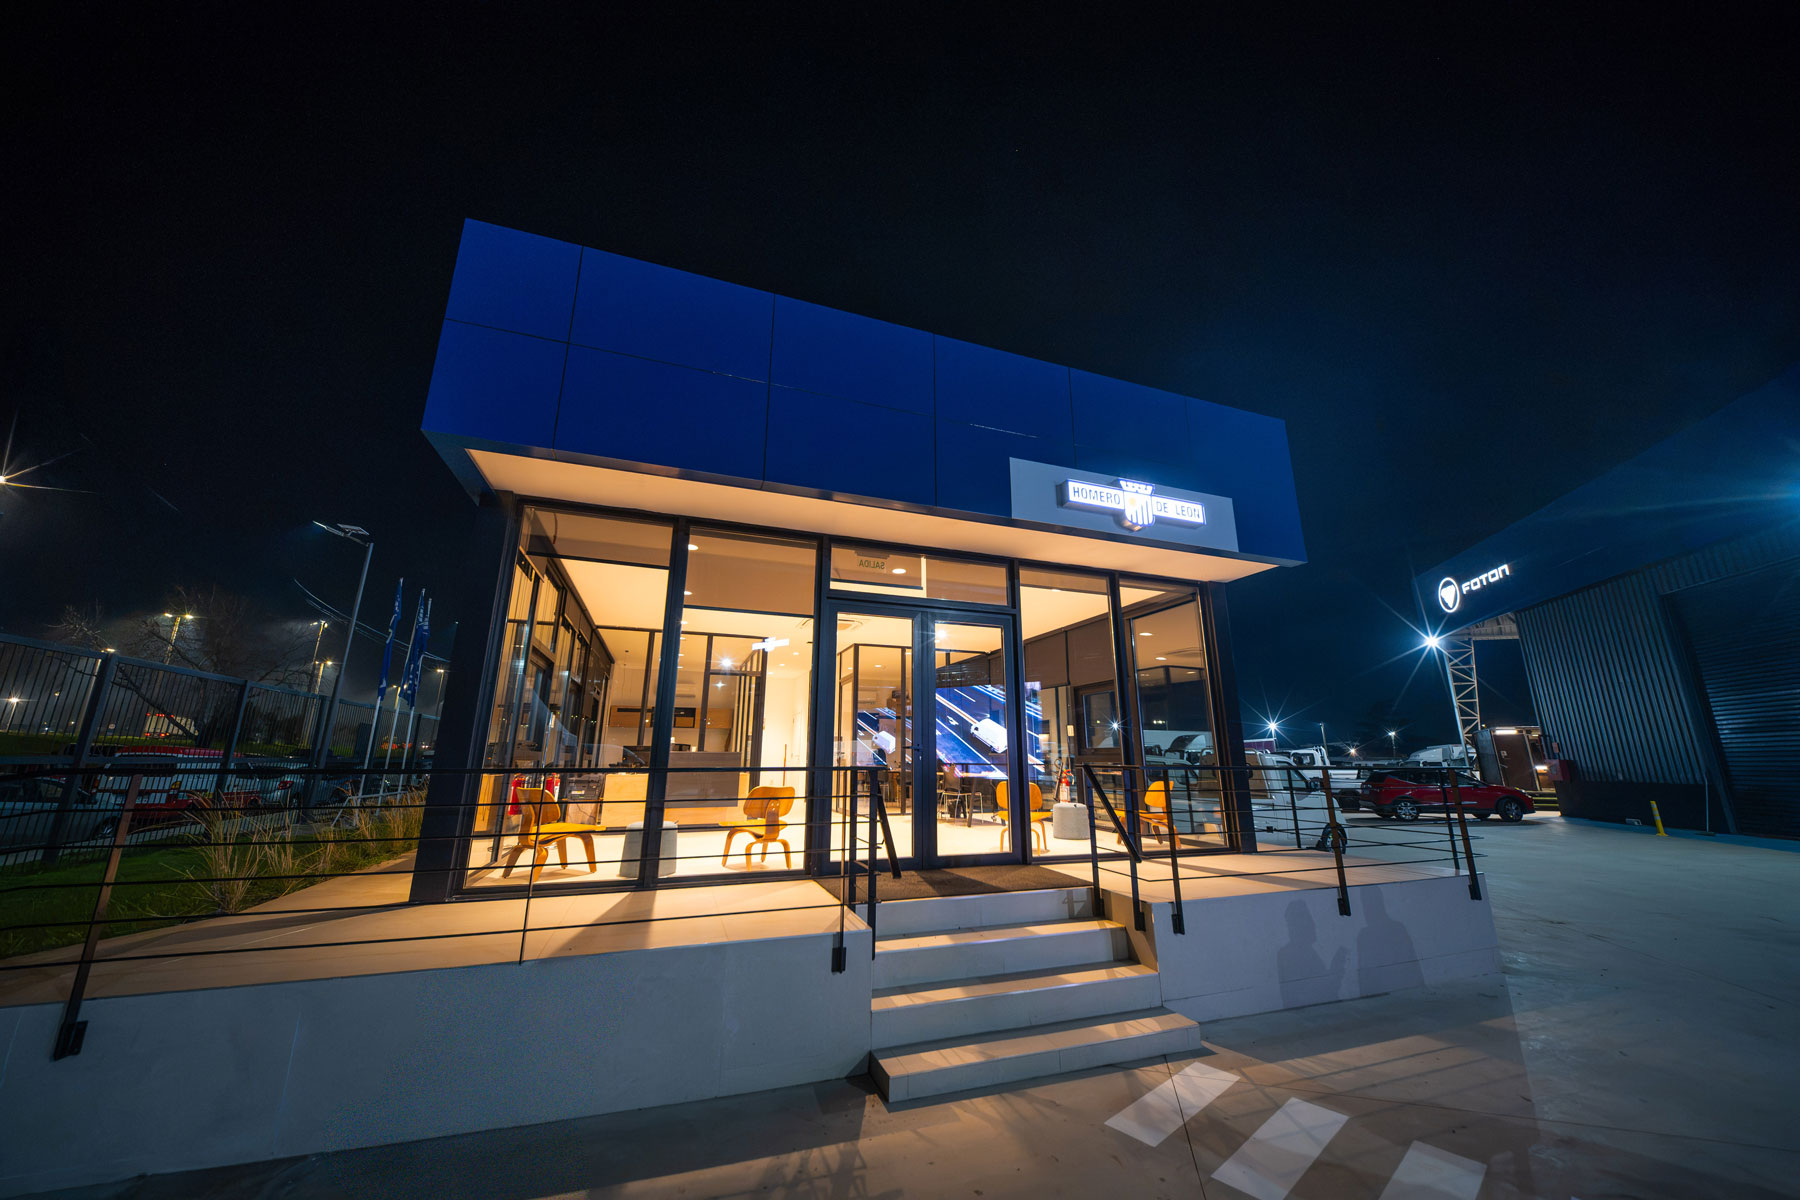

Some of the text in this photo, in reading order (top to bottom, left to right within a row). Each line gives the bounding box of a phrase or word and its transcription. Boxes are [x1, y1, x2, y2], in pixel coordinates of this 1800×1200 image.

[1072, 486, 1200, 519] HOMERO DE LEON
[1461, 564, 1509, 594] FOTON
